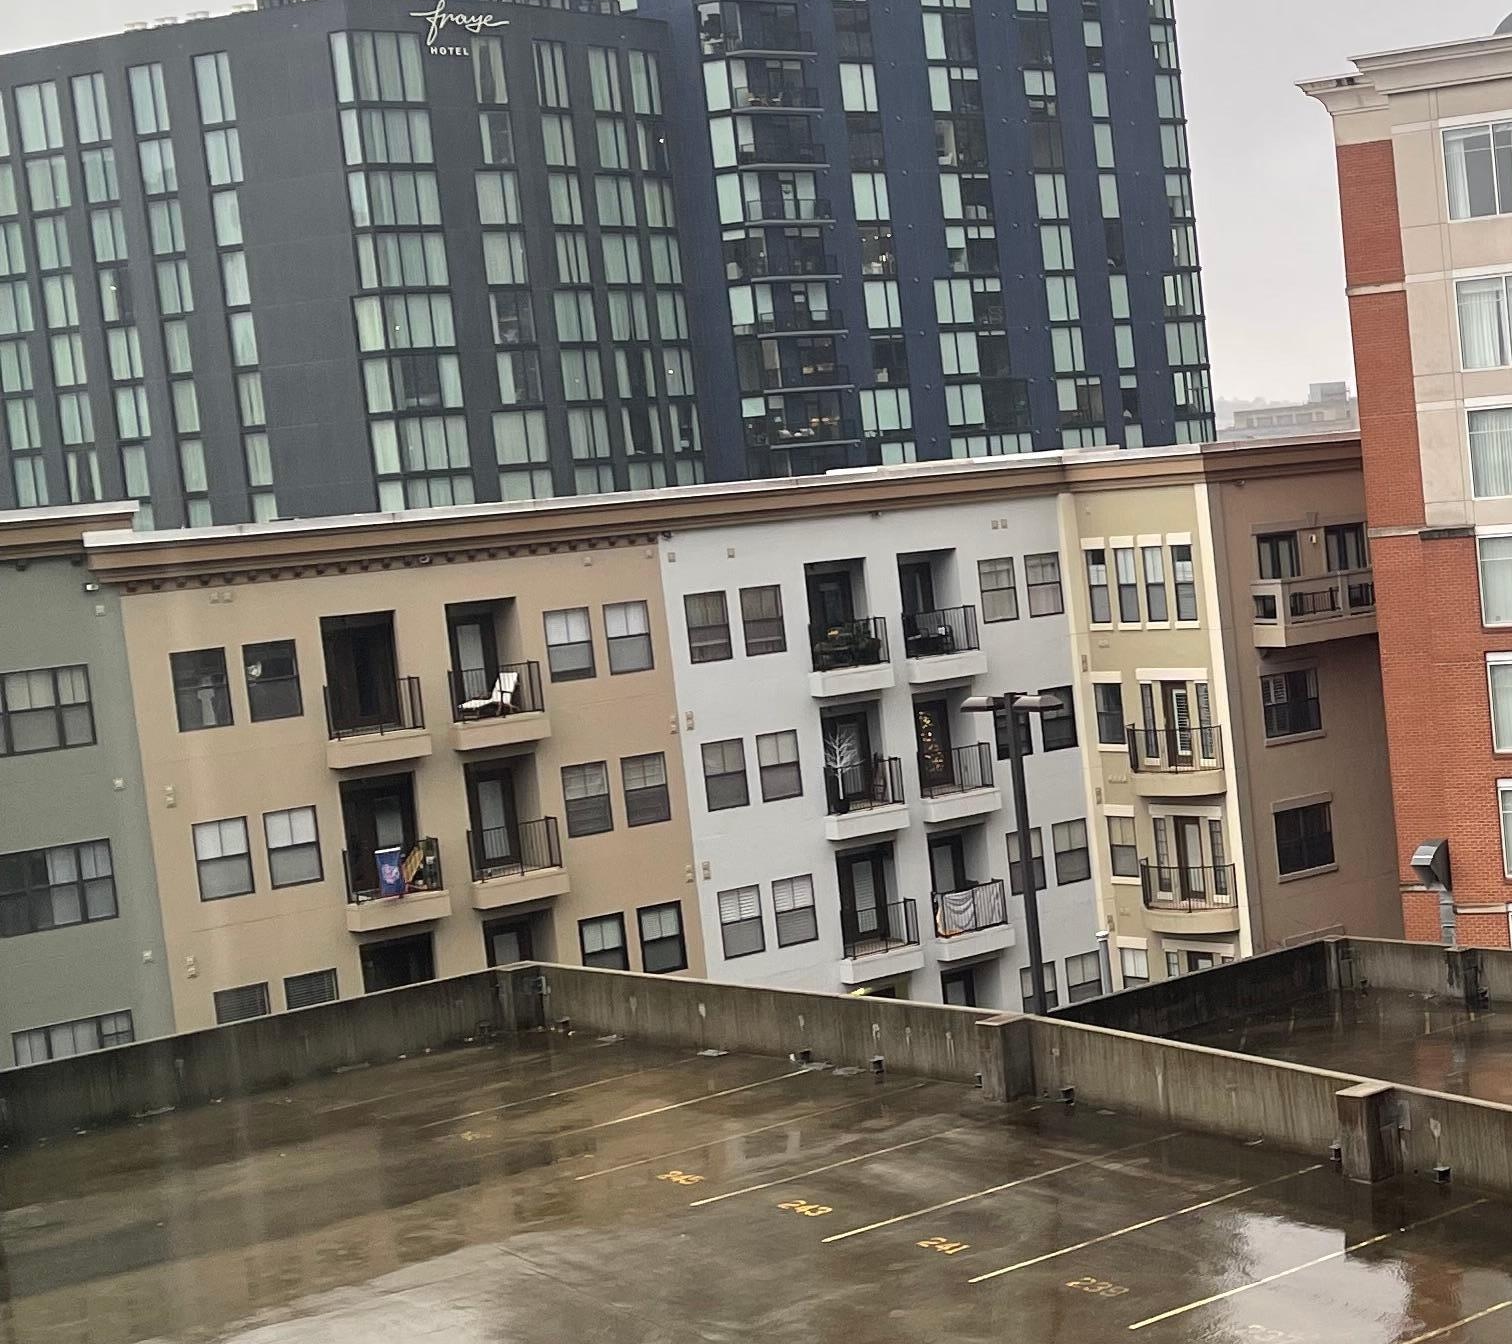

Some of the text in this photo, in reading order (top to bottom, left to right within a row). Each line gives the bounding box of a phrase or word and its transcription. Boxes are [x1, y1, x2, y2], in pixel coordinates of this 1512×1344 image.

[409, 0, 510, 46] fraye
[430, 47, 469, 56] HOTEL
[777, 1199, 833, 1217] 243
[915, 1236, 971, 1255] 241
[1064, 1276, 1130, 1297] 239
